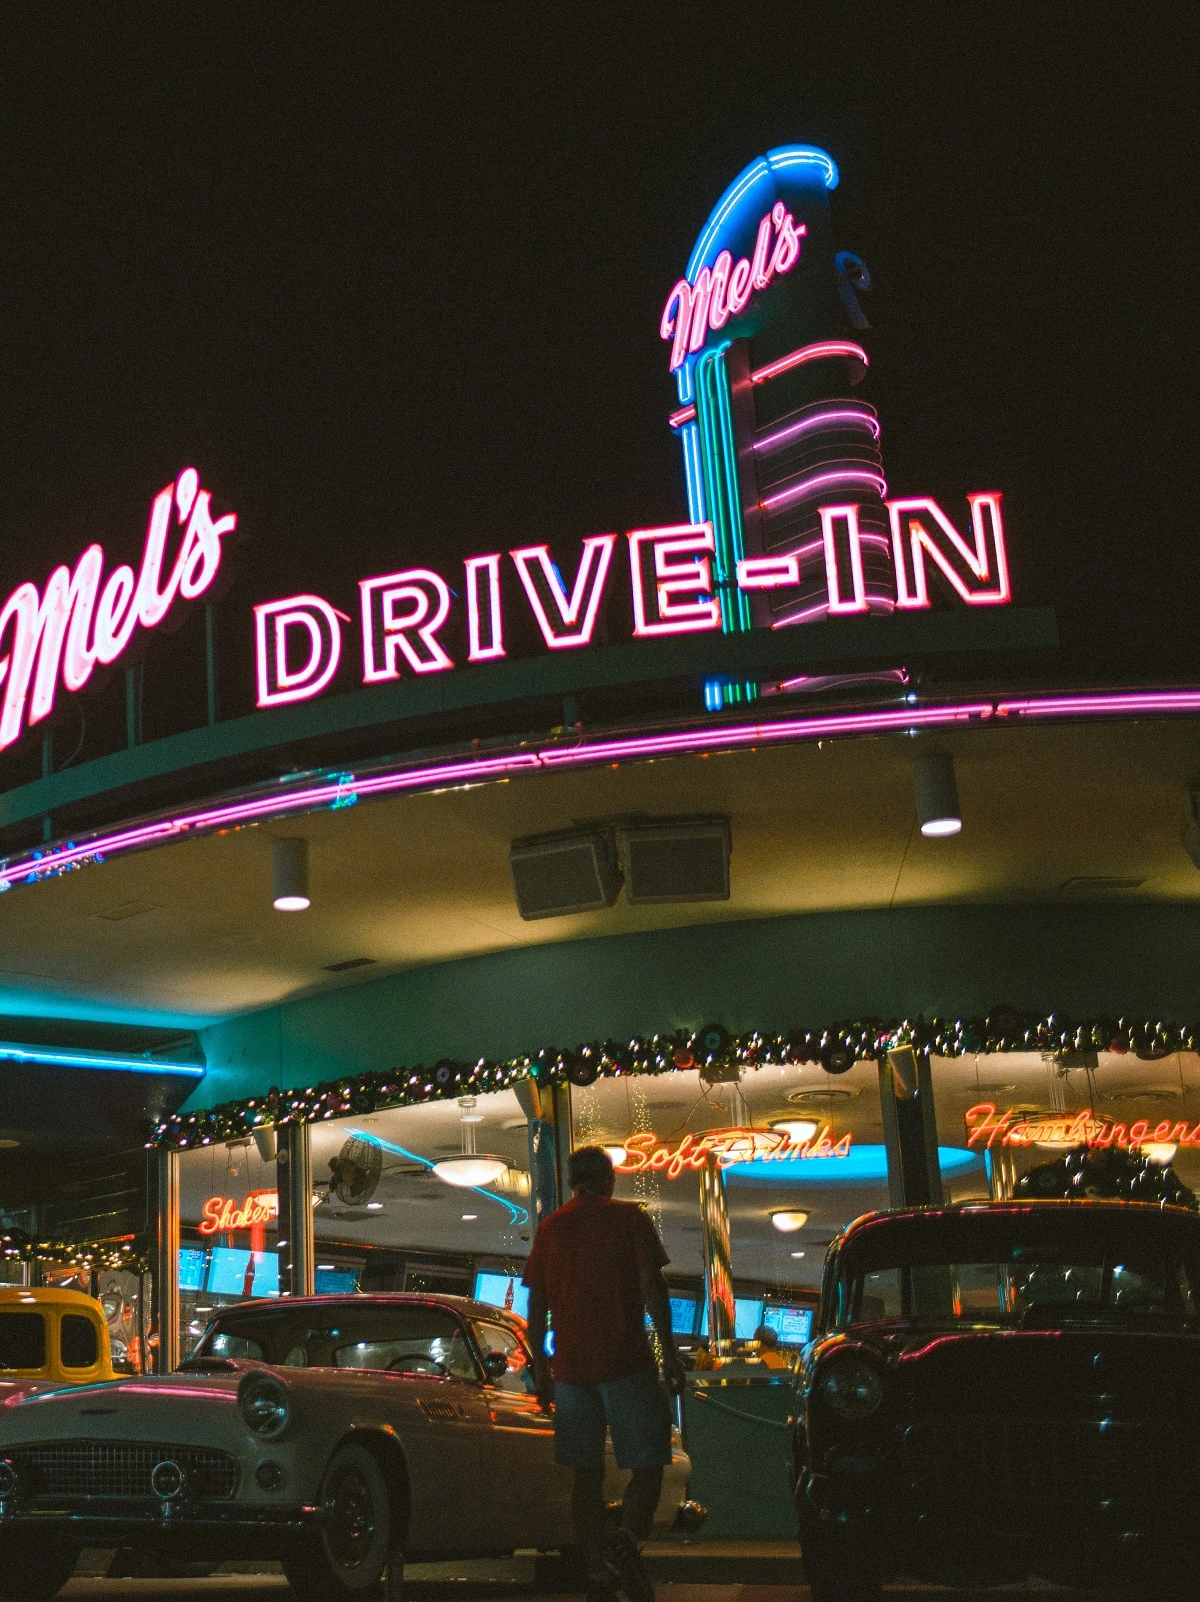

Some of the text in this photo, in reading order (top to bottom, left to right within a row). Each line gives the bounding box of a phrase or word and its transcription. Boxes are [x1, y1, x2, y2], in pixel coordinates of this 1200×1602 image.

[660, 199, 808, 373] Mel's
[254, 493, 1010, 708] DRIVE-IN
[613, 1126, 853, 1180] Soft Drinks
[200, 1196, 274, 1234] Shakes
